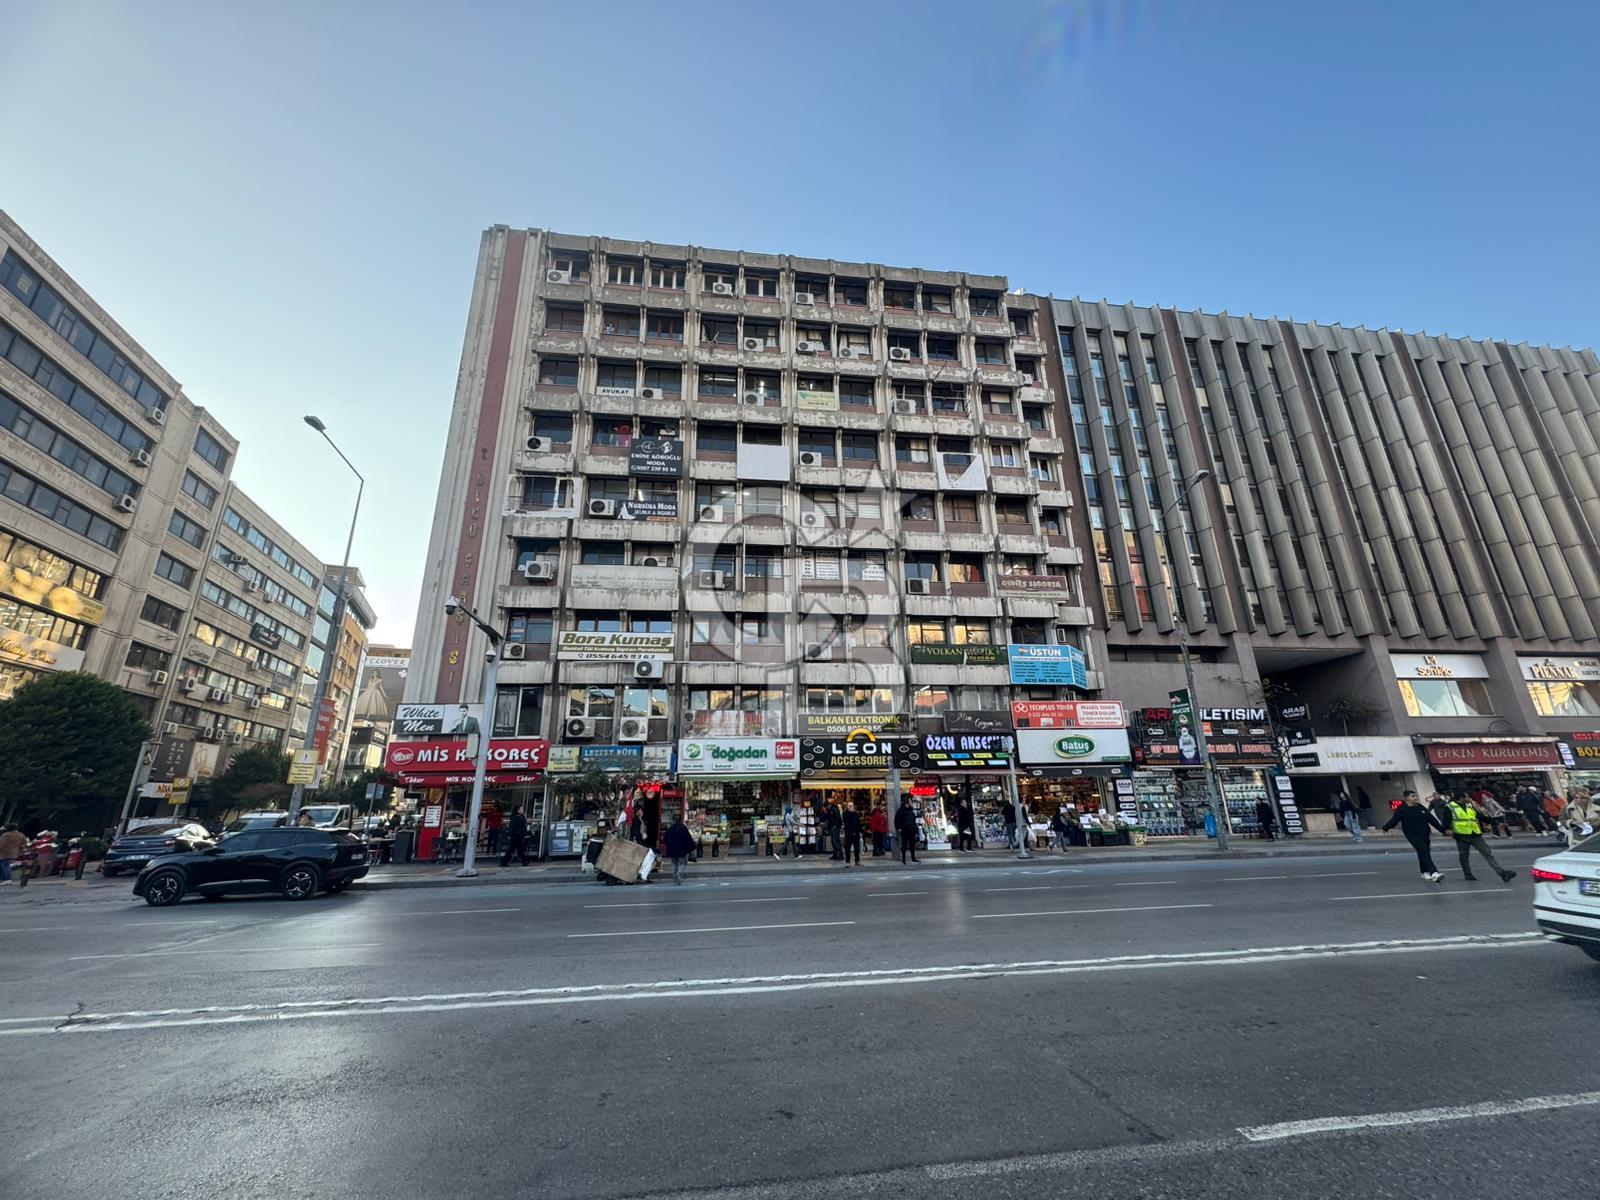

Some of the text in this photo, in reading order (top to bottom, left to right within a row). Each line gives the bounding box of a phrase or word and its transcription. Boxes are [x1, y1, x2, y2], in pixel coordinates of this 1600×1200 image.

[657, 502, 676, 510] MODA
[563, 633, 673, 646] Bora Kumaş
[926, 647, 962, 656] VOLKAN
[1029, 646, 1062, 656] ÜSTÜN
[402, 706, 440, 719] White
[402, 719, 435, 732] Men
[808, 714, 900, 725] BALKAN ELEKTRONİK
[831, 742, 892, 755] LEON
[925, 734, 955, 750] ÖZEN
[1062, 741, 1089, 752] Batuş
[417, 746, 449, 762] MİS
[711, 746, 768, 762] doğadan
